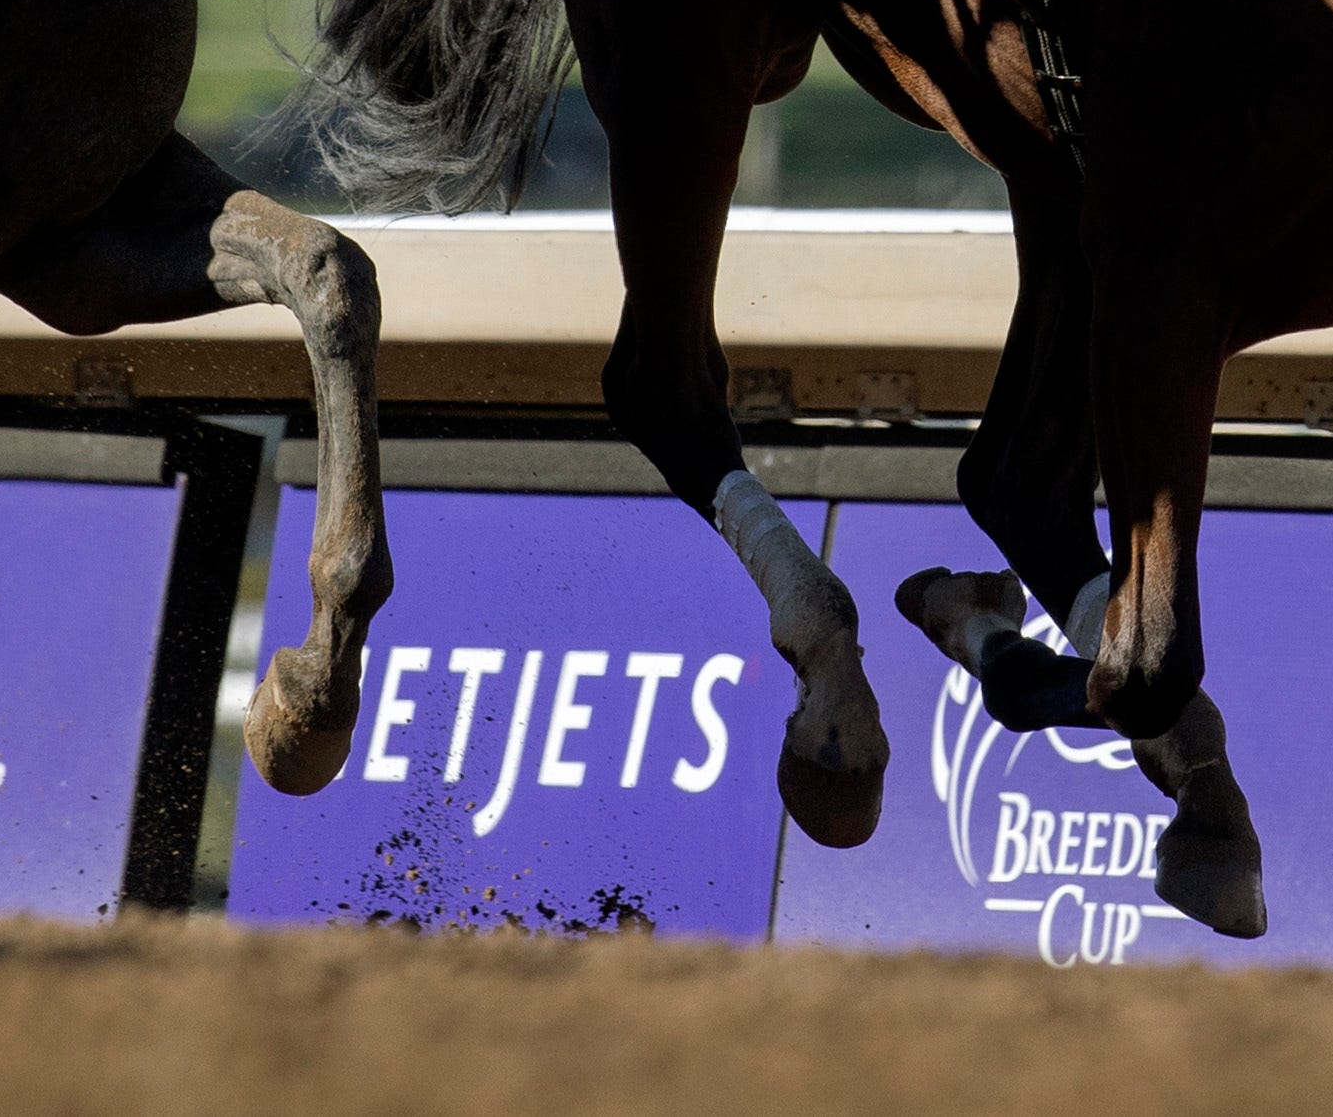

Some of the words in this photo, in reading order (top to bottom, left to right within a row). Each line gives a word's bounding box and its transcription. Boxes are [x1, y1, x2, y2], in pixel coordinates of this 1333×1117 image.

[335, 646, 745, 838] ETJETS
[988, 791, 1170, 883] BREEDE
[1038, 884, 1141, 969] CUP
